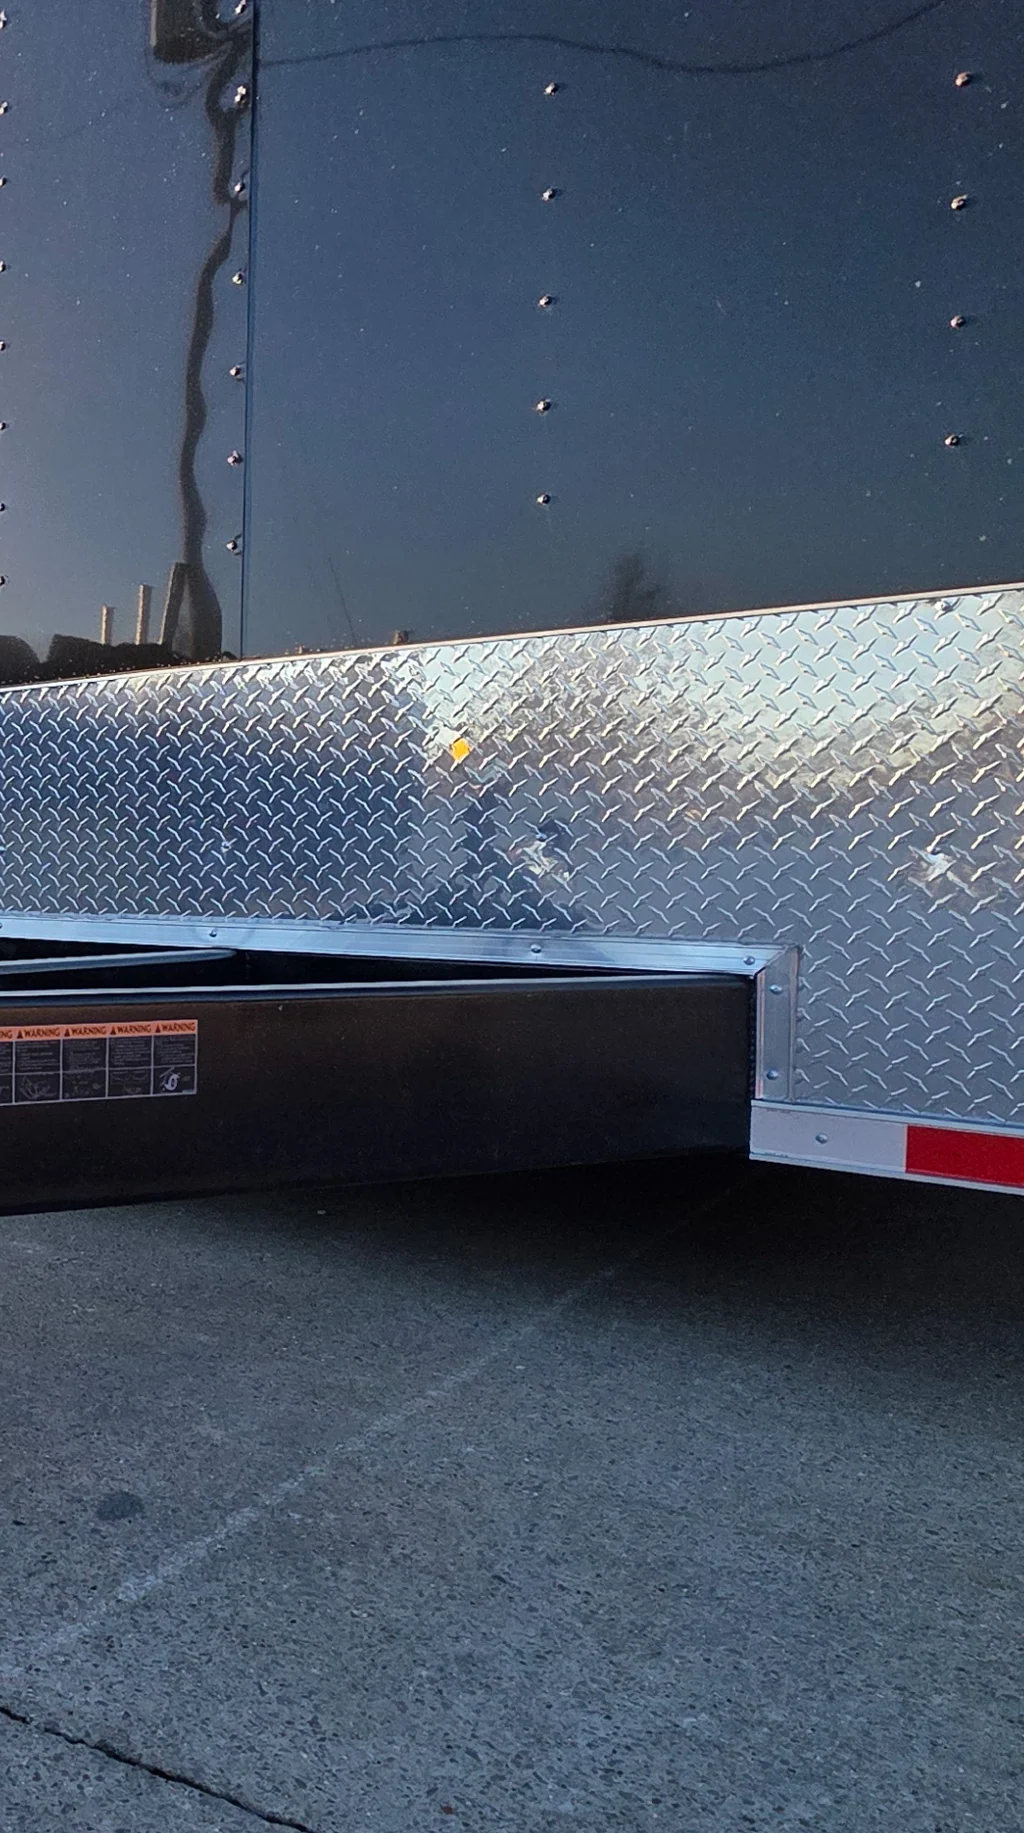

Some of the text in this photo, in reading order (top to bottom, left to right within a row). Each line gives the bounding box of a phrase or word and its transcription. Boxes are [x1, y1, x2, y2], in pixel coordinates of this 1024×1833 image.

[71, 1026, 107, 1036] WARNING
[117, 1024, 152, 1034] WARNING
[162, 1022, 196, 1032] WARNING
[24, 1028, 60, 1038] WARNING
